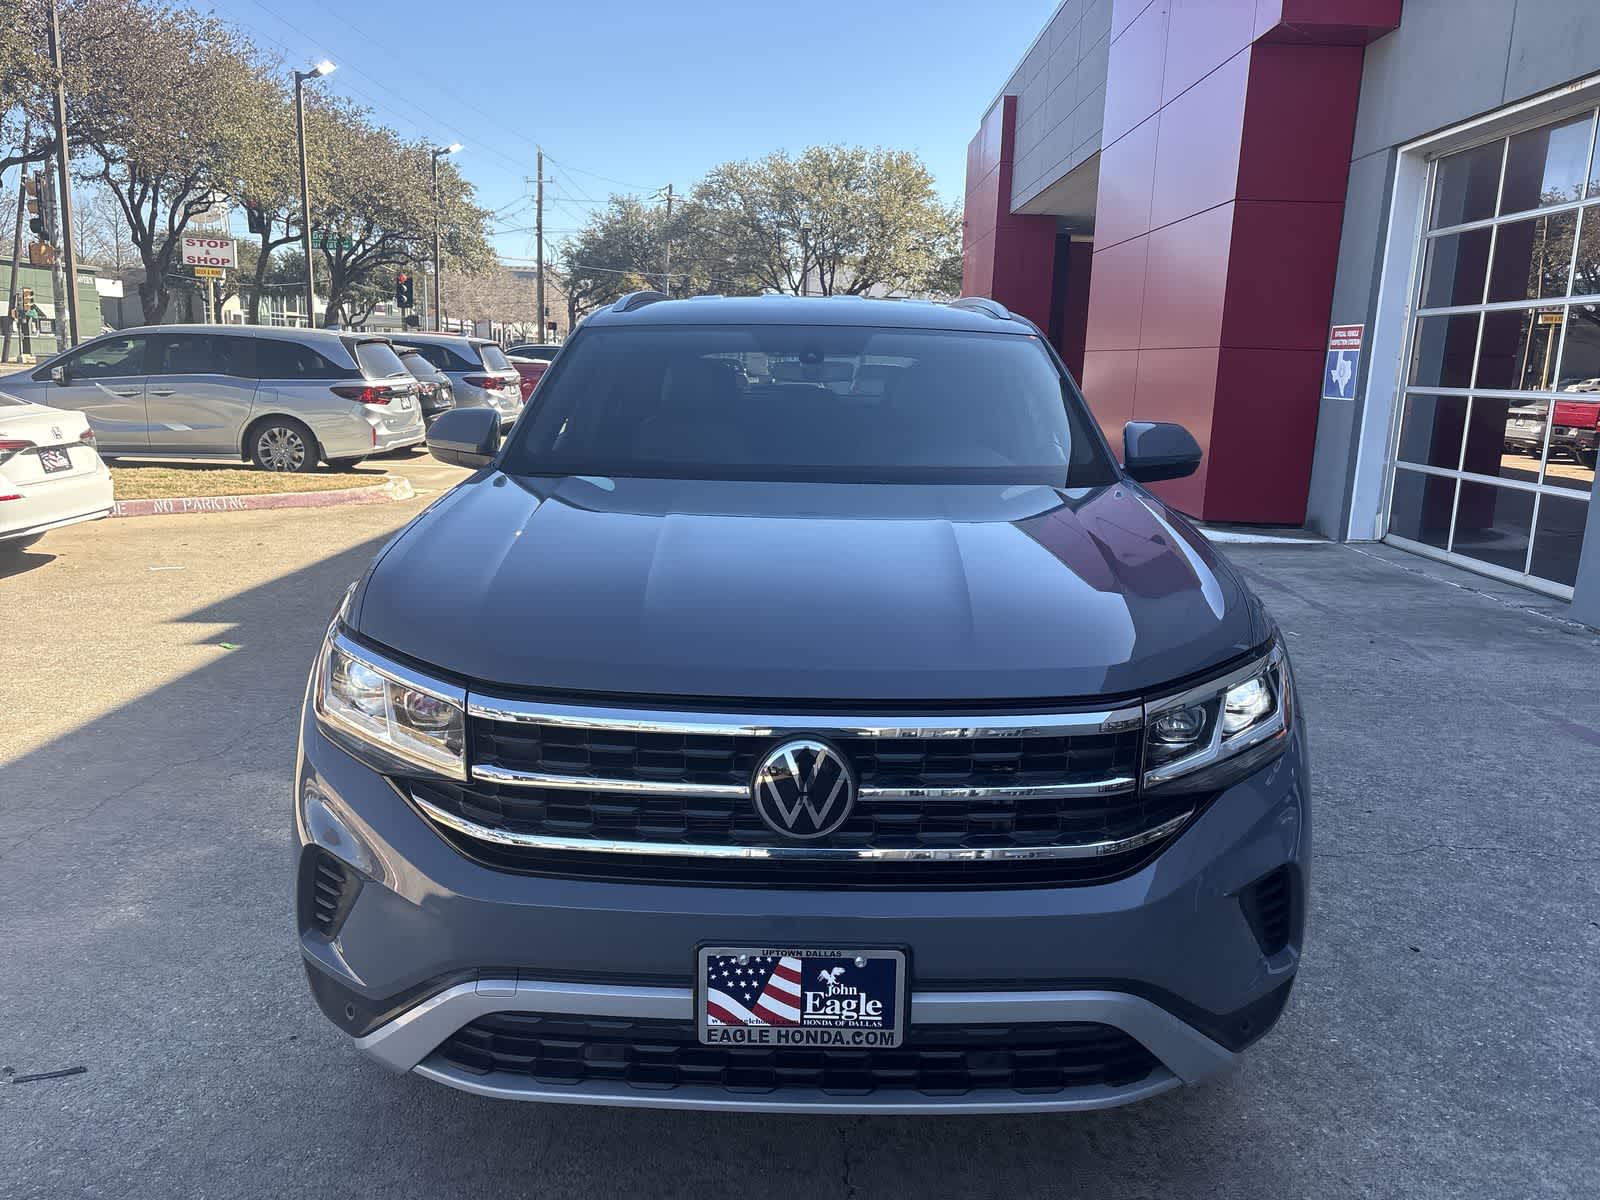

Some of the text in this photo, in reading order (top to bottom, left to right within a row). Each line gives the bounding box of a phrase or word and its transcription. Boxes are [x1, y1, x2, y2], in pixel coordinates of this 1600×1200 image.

[186, 239, 229, 248] STOP
[186, 256, 231, 265] SHOP
[152, 500, 173, 513] NO
[183, 498, 248, 512] PARKING
[762, 949, 803, 957] UPTOWN
[825, 984, 858, 997] John
[803, 991, 883, 1021] Eagle
[803, 1019, 833, 1027] HONDA
[848, 1020, 883, 1028] DALLAS
[707, 1028, 895, 1046] EAGLE HONDA.COM
